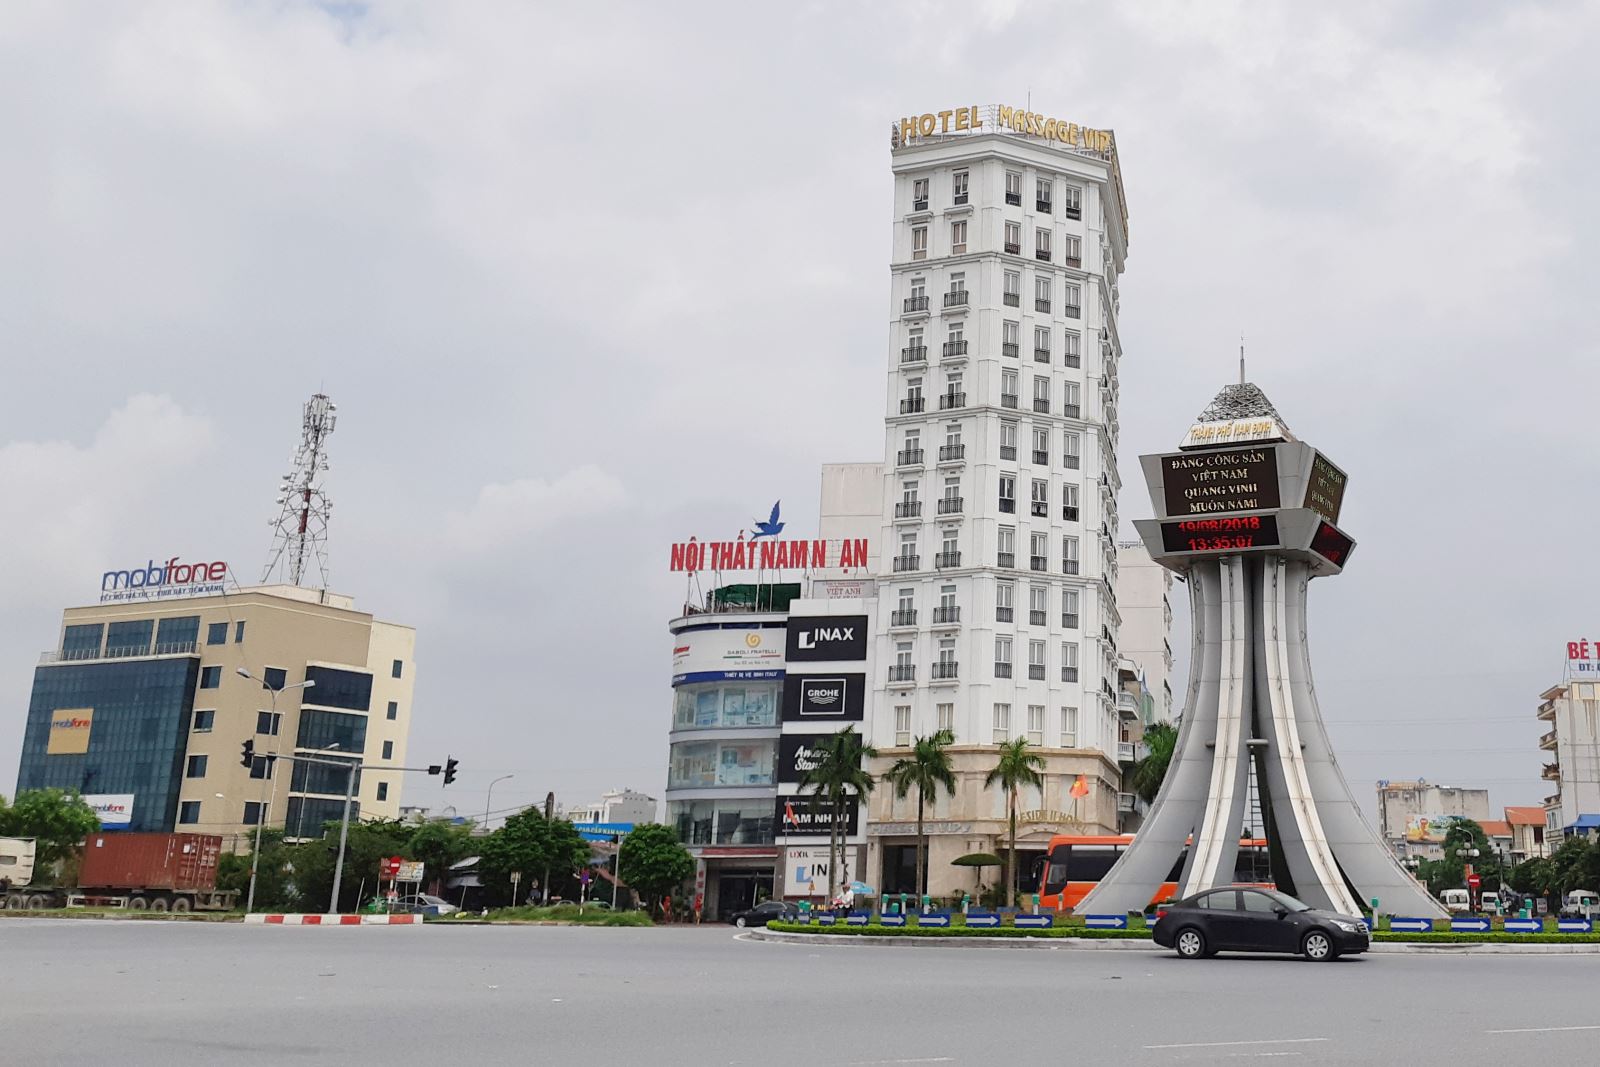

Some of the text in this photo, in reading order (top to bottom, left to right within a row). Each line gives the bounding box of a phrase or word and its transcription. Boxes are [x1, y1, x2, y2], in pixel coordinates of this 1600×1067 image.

[901, 105, 983, 143] HOTEL
[998, 104, 1111, 152] MASSAGE VIP
[1192, 468, 1248, 483] VIỆT NAM
[1184, 483, 1258, 499] QUANG VINH
[1178, 516, 1261, 531] 19/08/2018
[670, 536, 706, 577] NỘI
[709, 529, 758, 570] THẤT
[760, 540, 808, 569] NAM
[102, 557, 227, 591] mobifone
[1566, 637, 1590, 660] BÊ
[807, 689, 840, 697] GROHE
[53, 718, 90, 728] mobifone
[92, 804, 124, 812] mobifone
[789, 850, 809, 858] LIXIL
